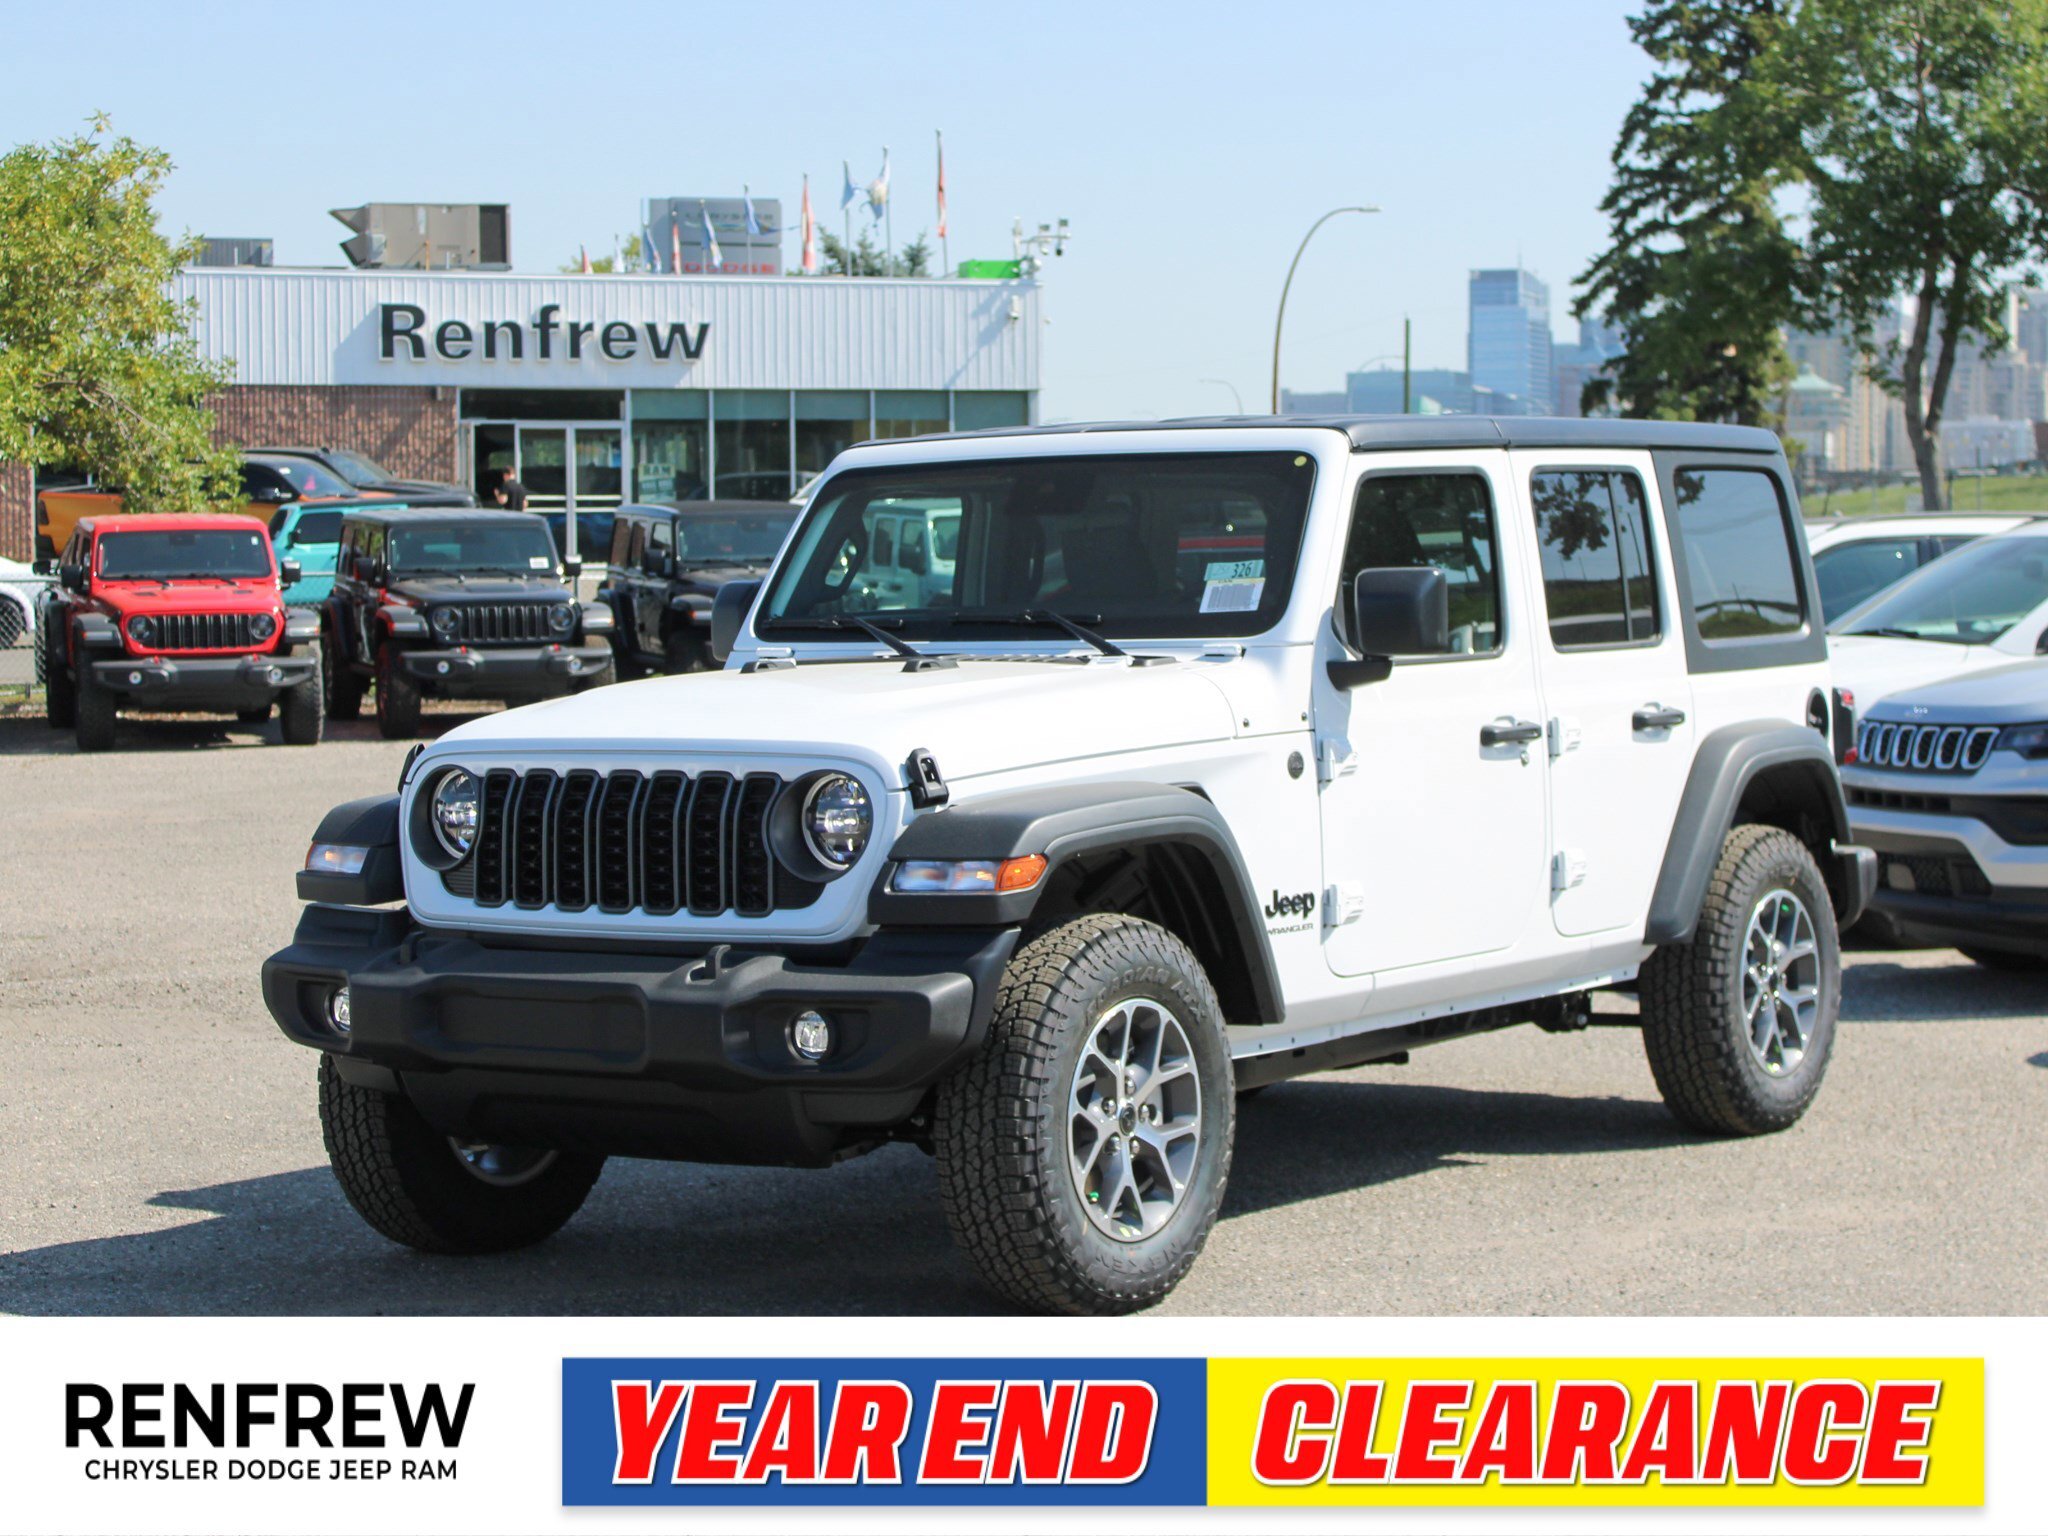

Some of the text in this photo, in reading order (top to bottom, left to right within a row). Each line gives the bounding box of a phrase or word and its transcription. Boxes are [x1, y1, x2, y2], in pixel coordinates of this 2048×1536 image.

[382, 305, 709, 360] Renfrew
[1231, 562, 1253, 579] 326
[1265, 889, 1315, 919] Jeep
